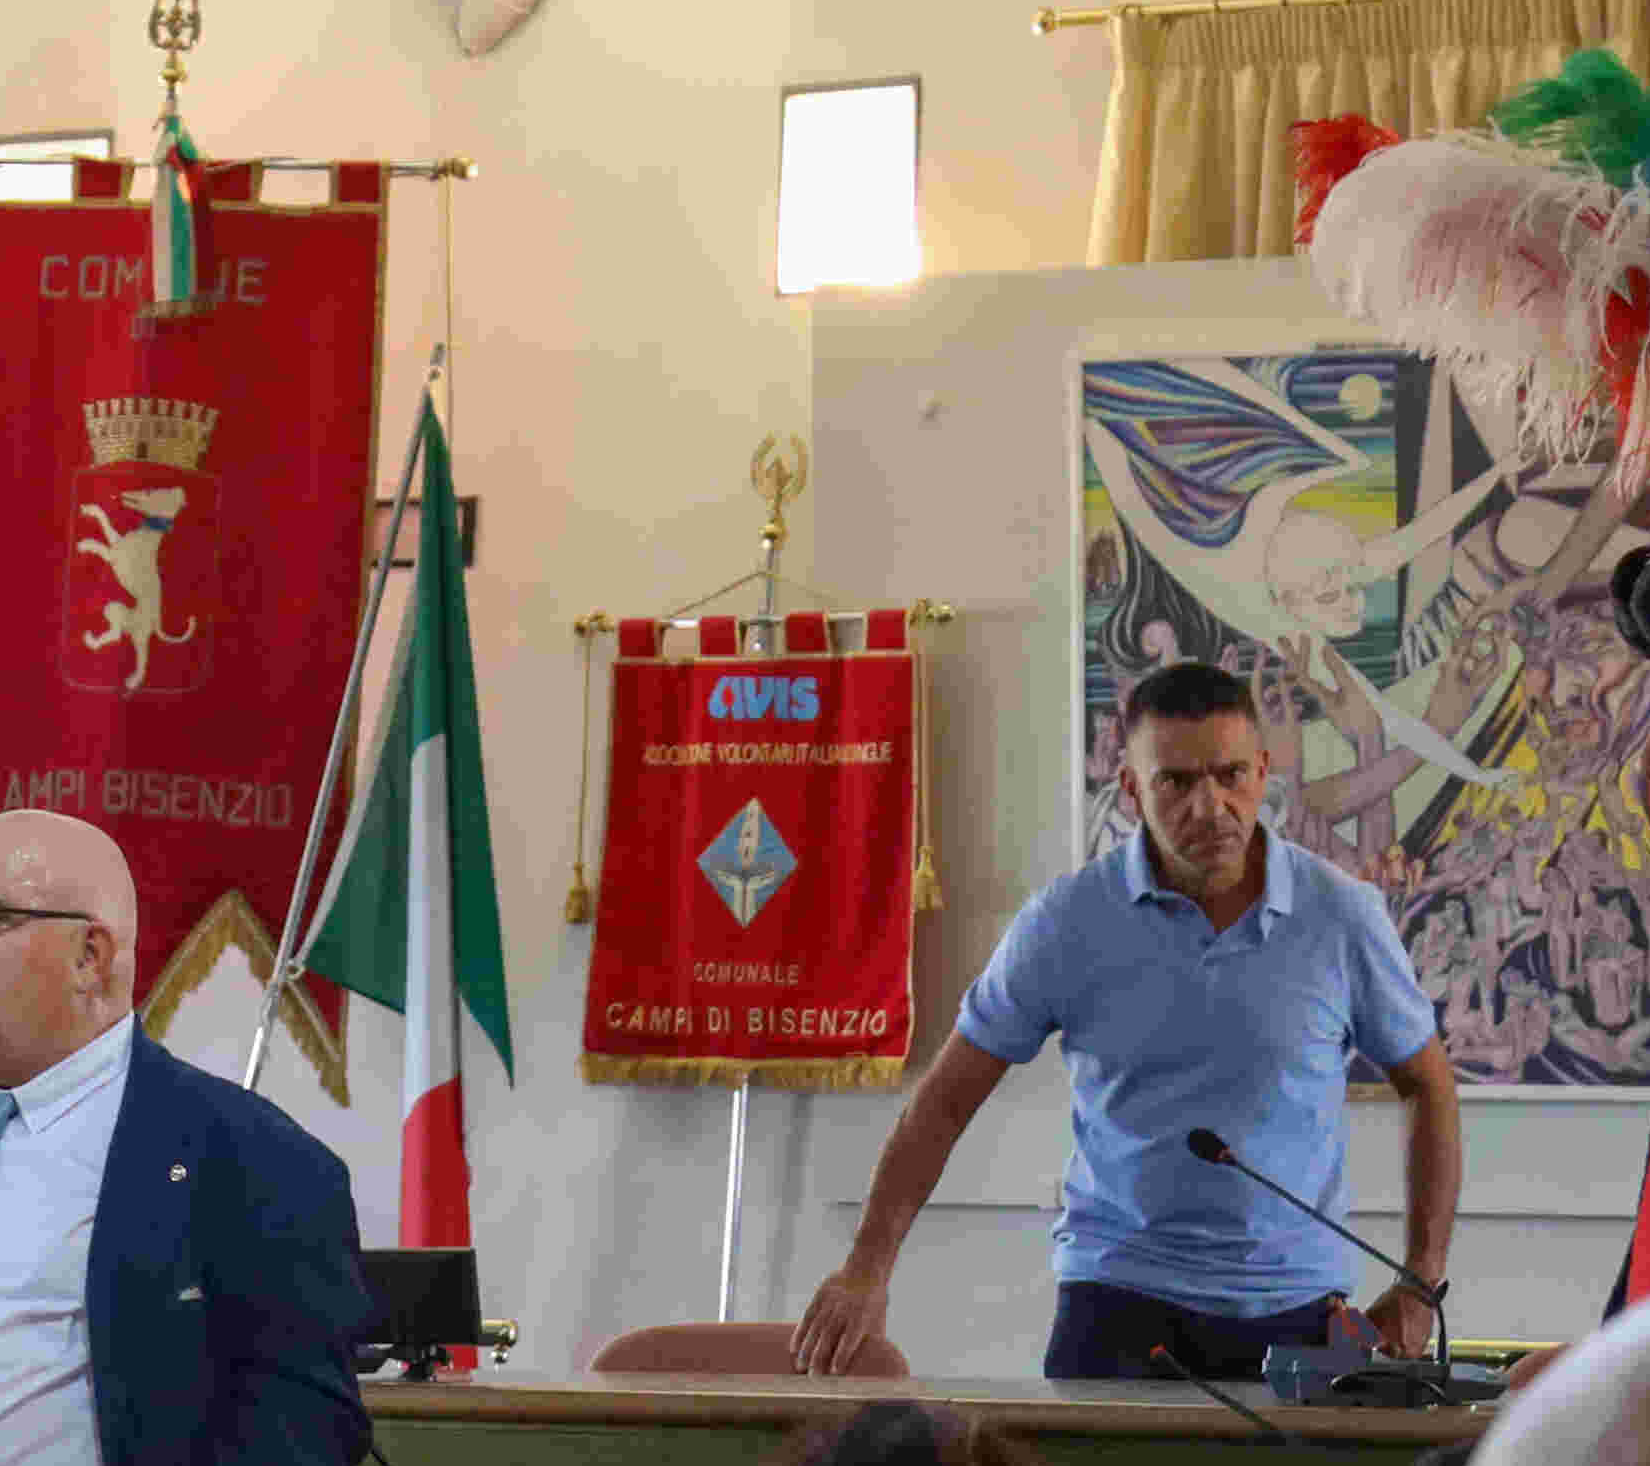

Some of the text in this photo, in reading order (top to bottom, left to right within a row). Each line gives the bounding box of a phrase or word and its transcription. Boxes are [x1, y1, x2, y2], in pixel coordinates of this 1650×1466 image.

[39, 254, 267, 300] COMUE
[708, 676, 820, 721] AVIS
[104, 769, 293, 828] BISENZIO
[693, 961, 798, 984] COMUNALE
[605, 1002, 887, 1036] CAMPI DI BISENZIO
